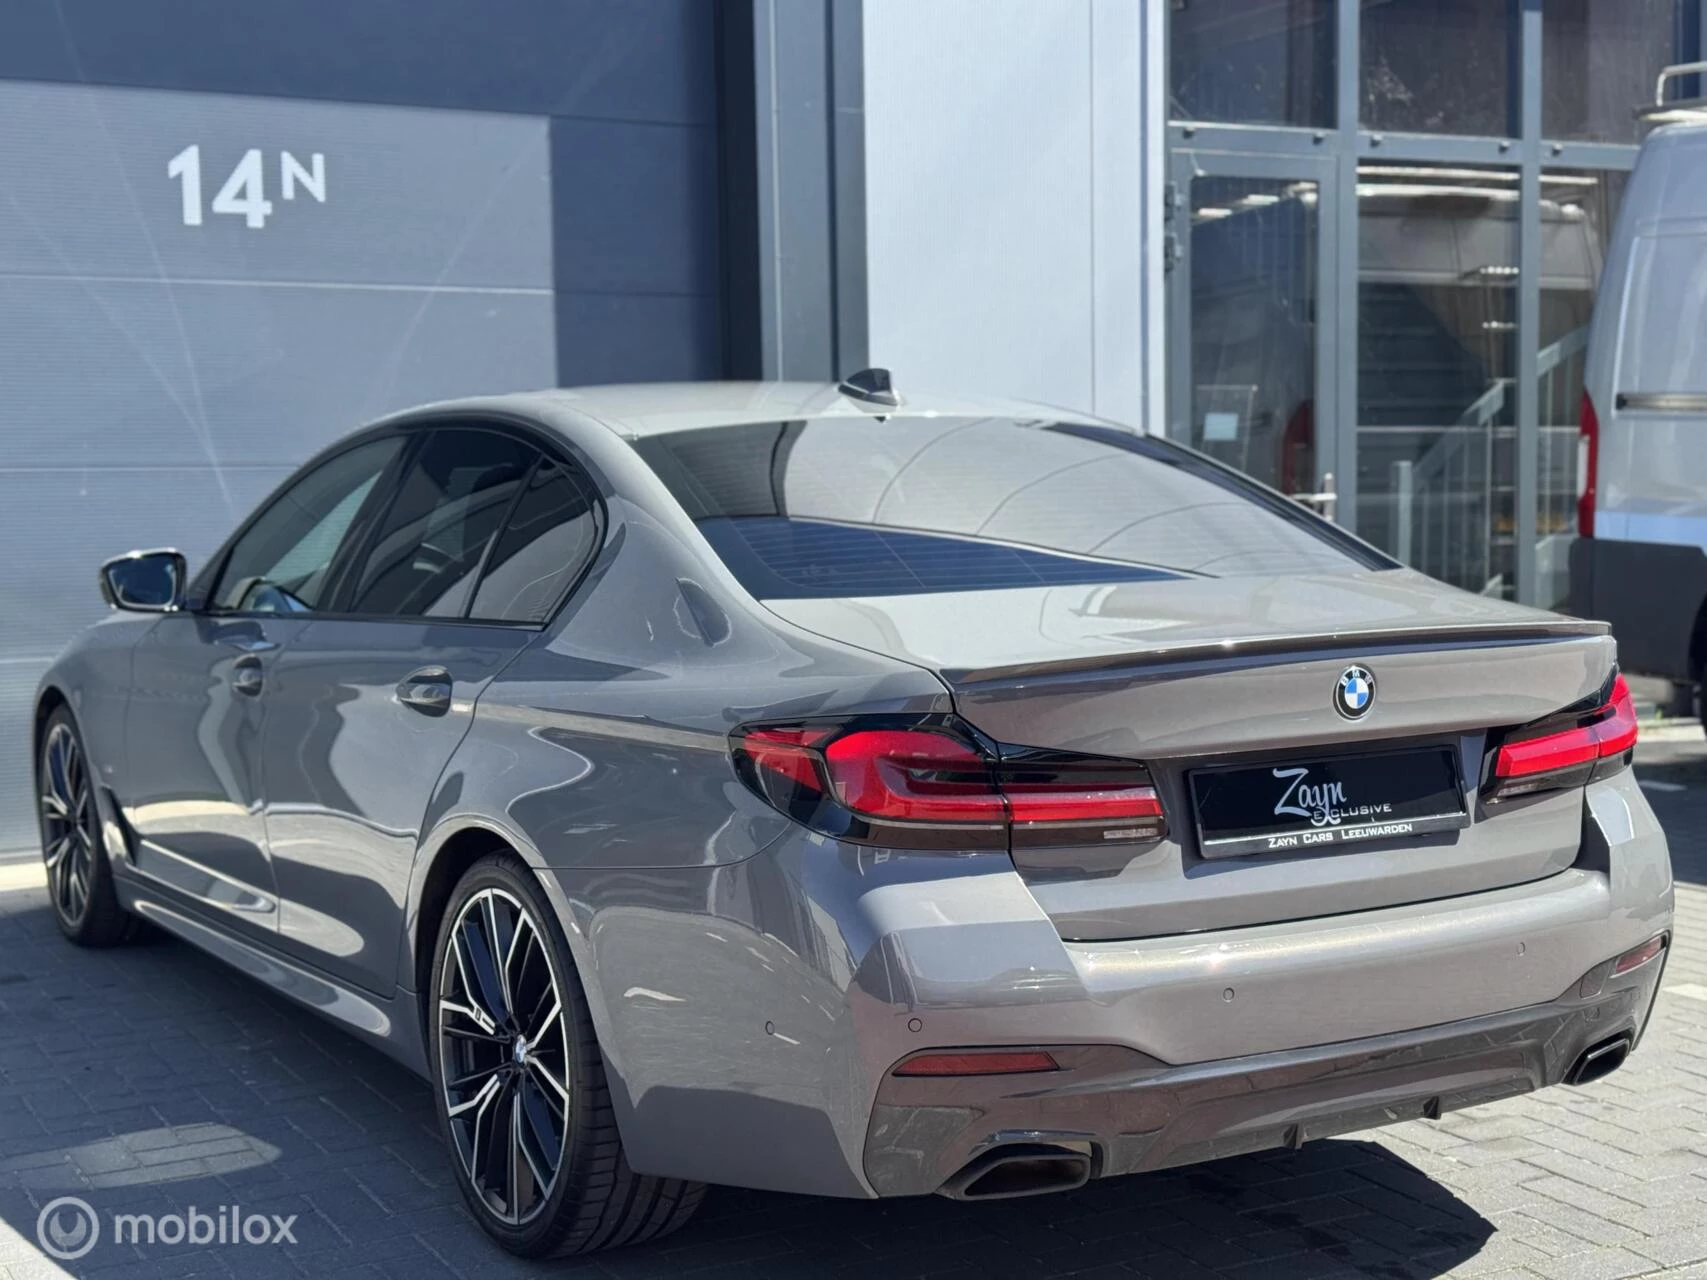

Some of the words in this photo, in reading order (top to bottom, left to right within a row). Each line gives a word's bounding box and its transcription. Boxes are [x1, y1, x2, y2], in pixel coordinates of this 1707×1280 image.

[1272, 767, 1347, 826] Zayn
[1268, 836, 1298, 848] ZAYN
[1303, 832, 1334, 844] CARS
